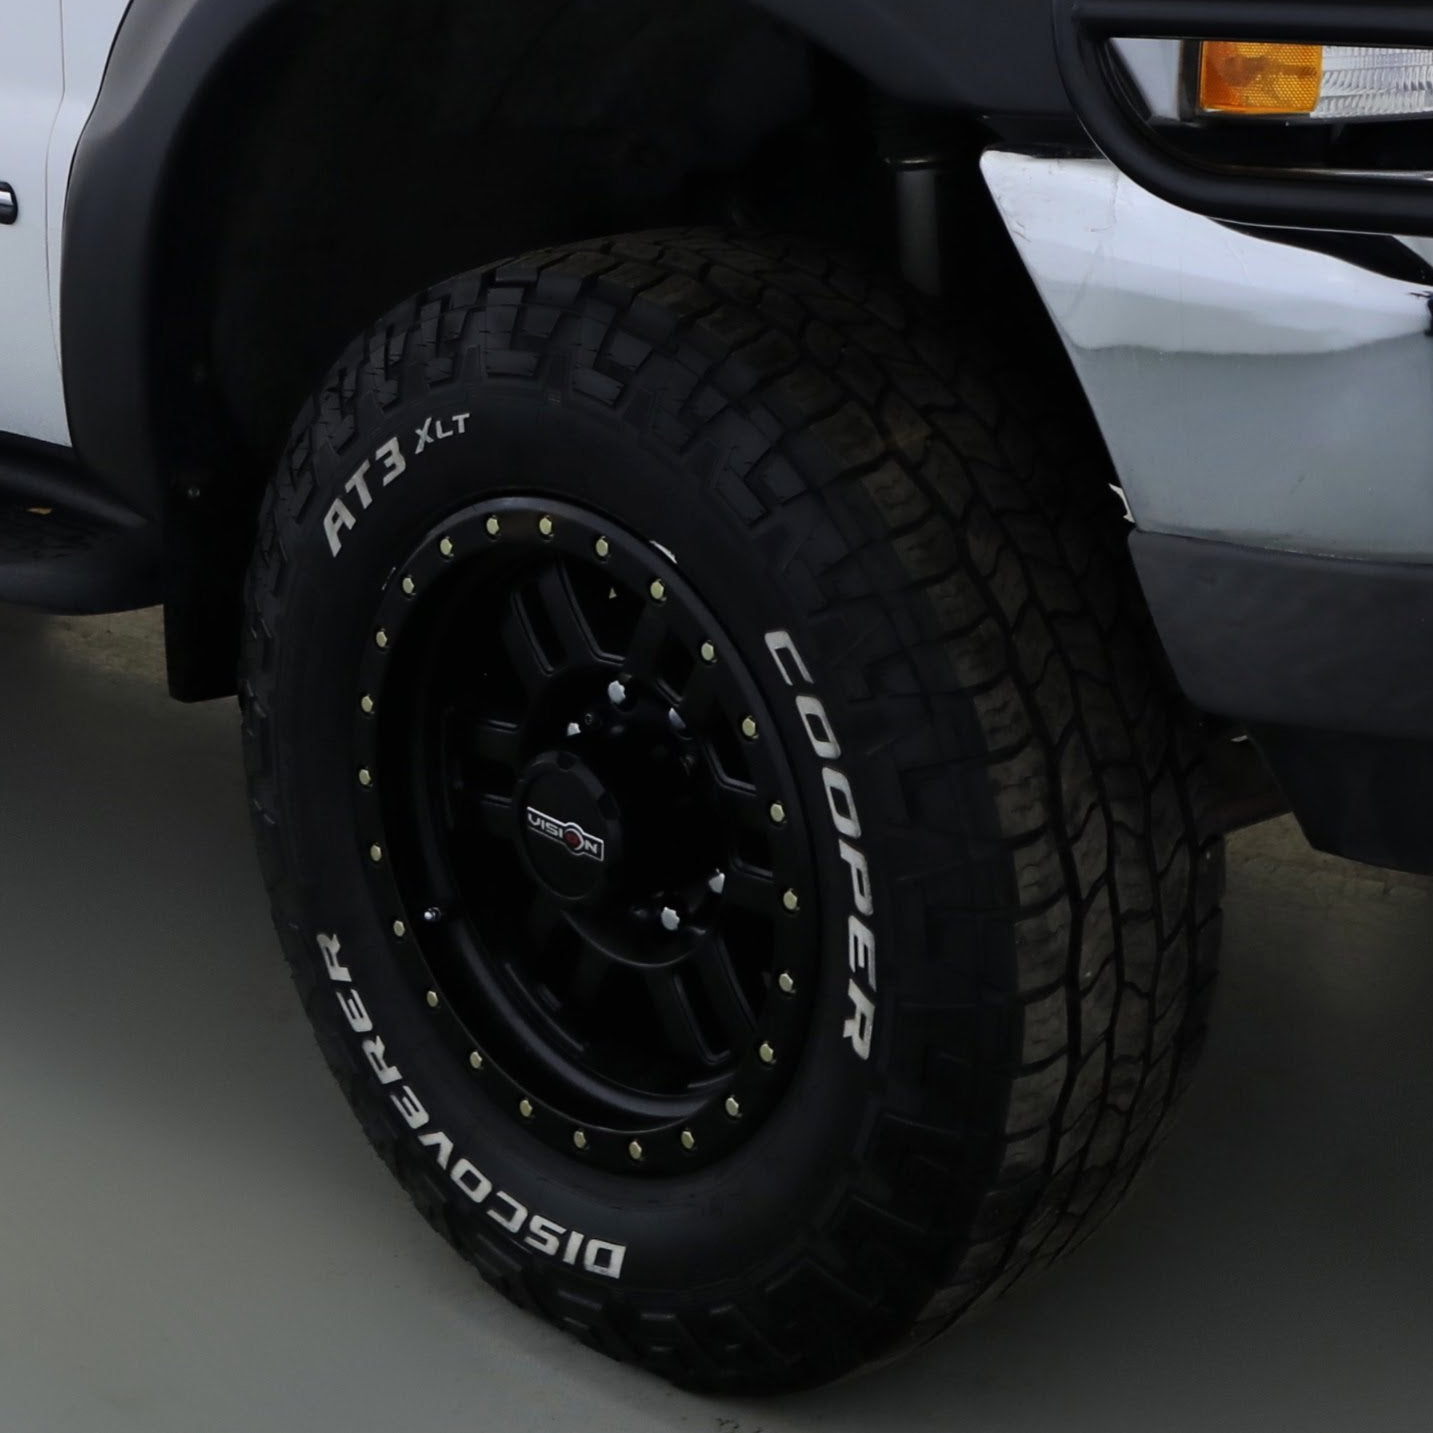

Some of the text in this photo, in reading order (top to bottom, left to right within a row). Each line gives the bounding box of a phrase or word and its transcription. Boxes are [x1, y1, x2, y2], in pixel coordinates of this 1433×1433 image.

[323, 412, 471, 558] AT3 XLT
[527, 813, 599, 855] VISION
[764, 629, 878, 1061] COOPER
[316, 932, 628, 1280] DISCOVERER
